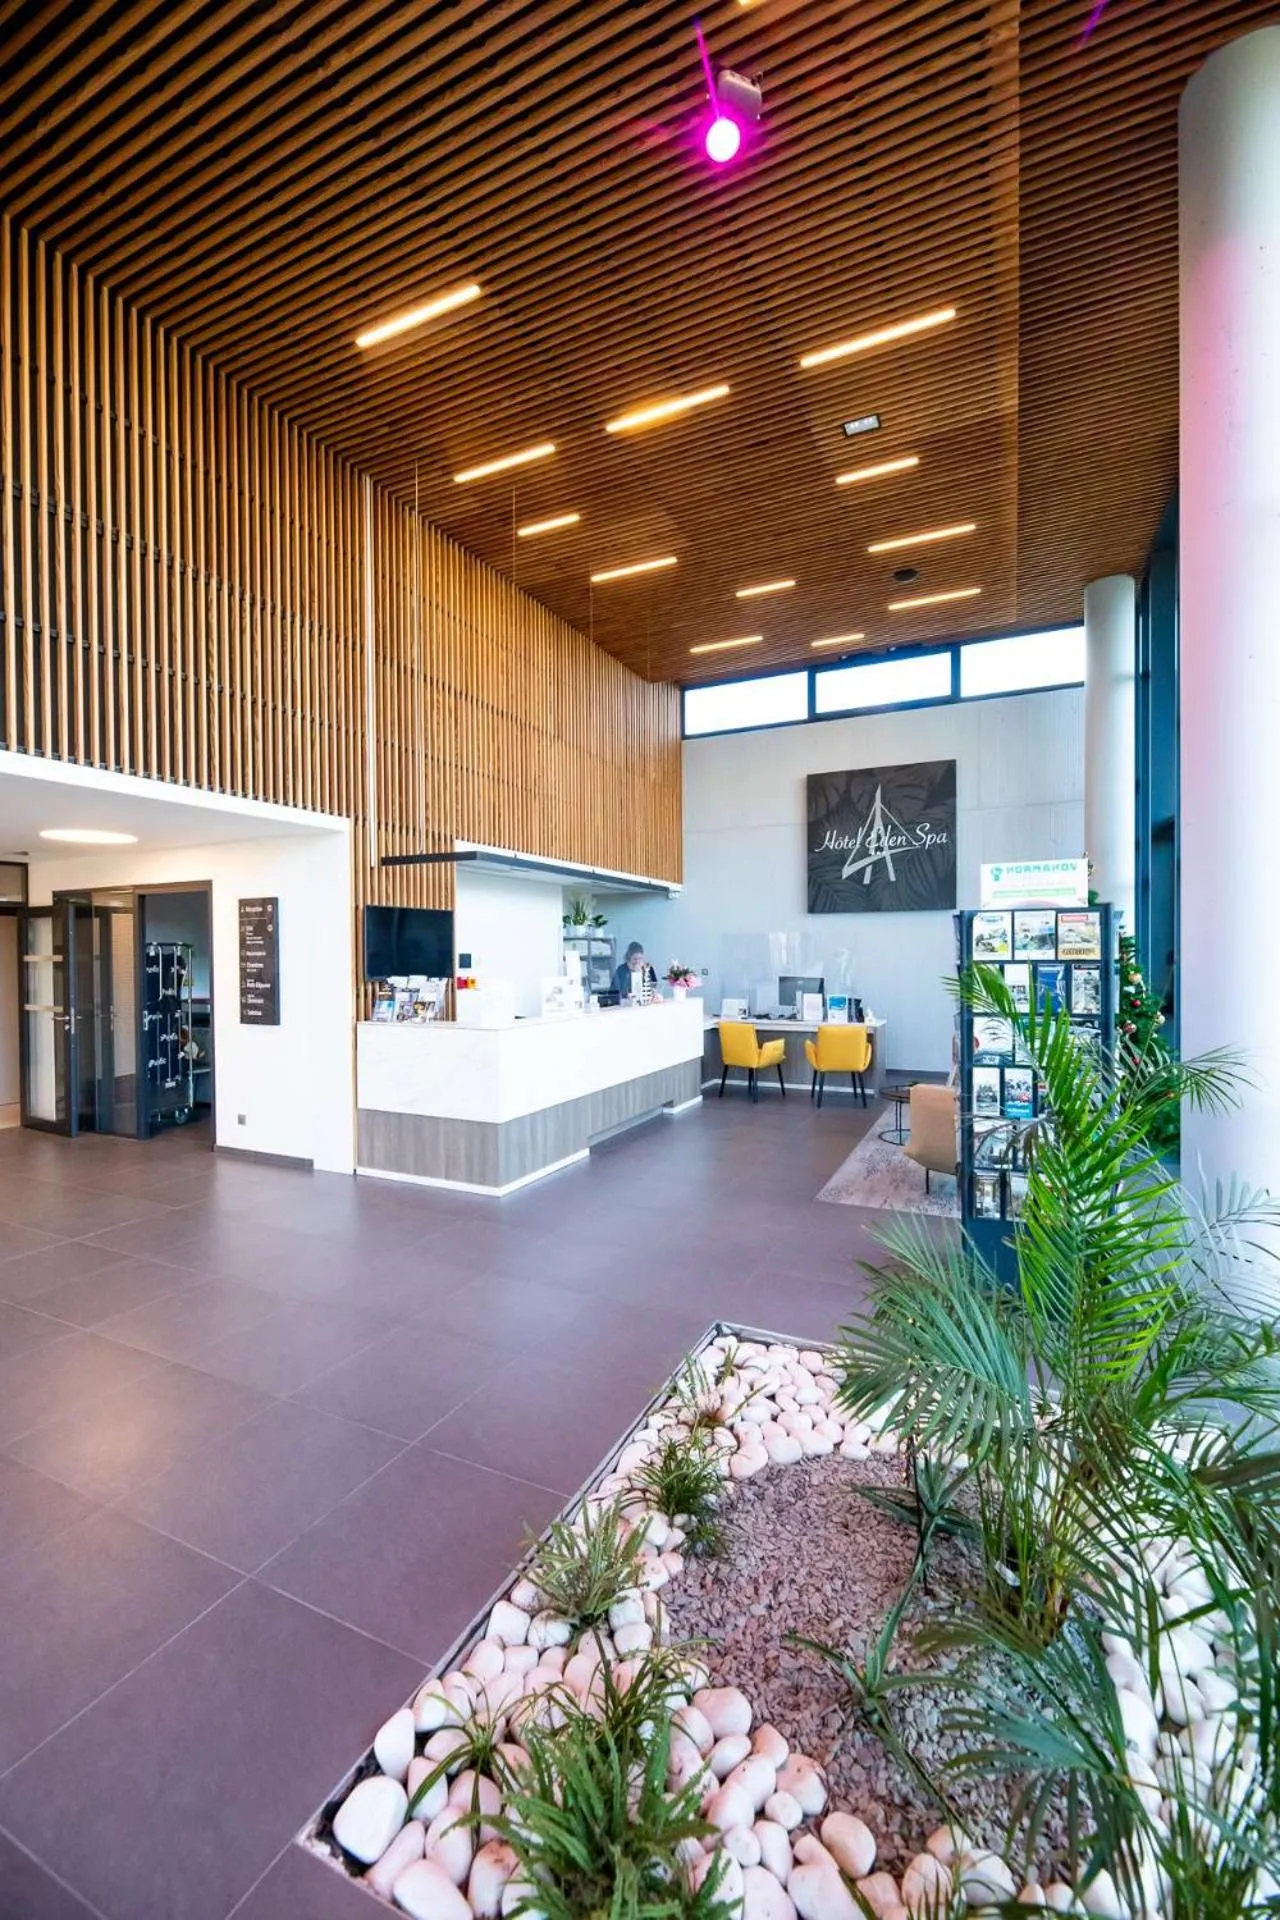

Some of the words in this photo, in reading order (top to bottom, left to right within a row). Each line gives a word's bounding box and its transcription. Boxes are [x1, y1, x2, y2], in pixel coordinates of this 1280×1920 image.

[814, 826, 862, 852] Hôtel
[865, 825, 907, 849] Eden
[913, 822, 948, 850] Spa
